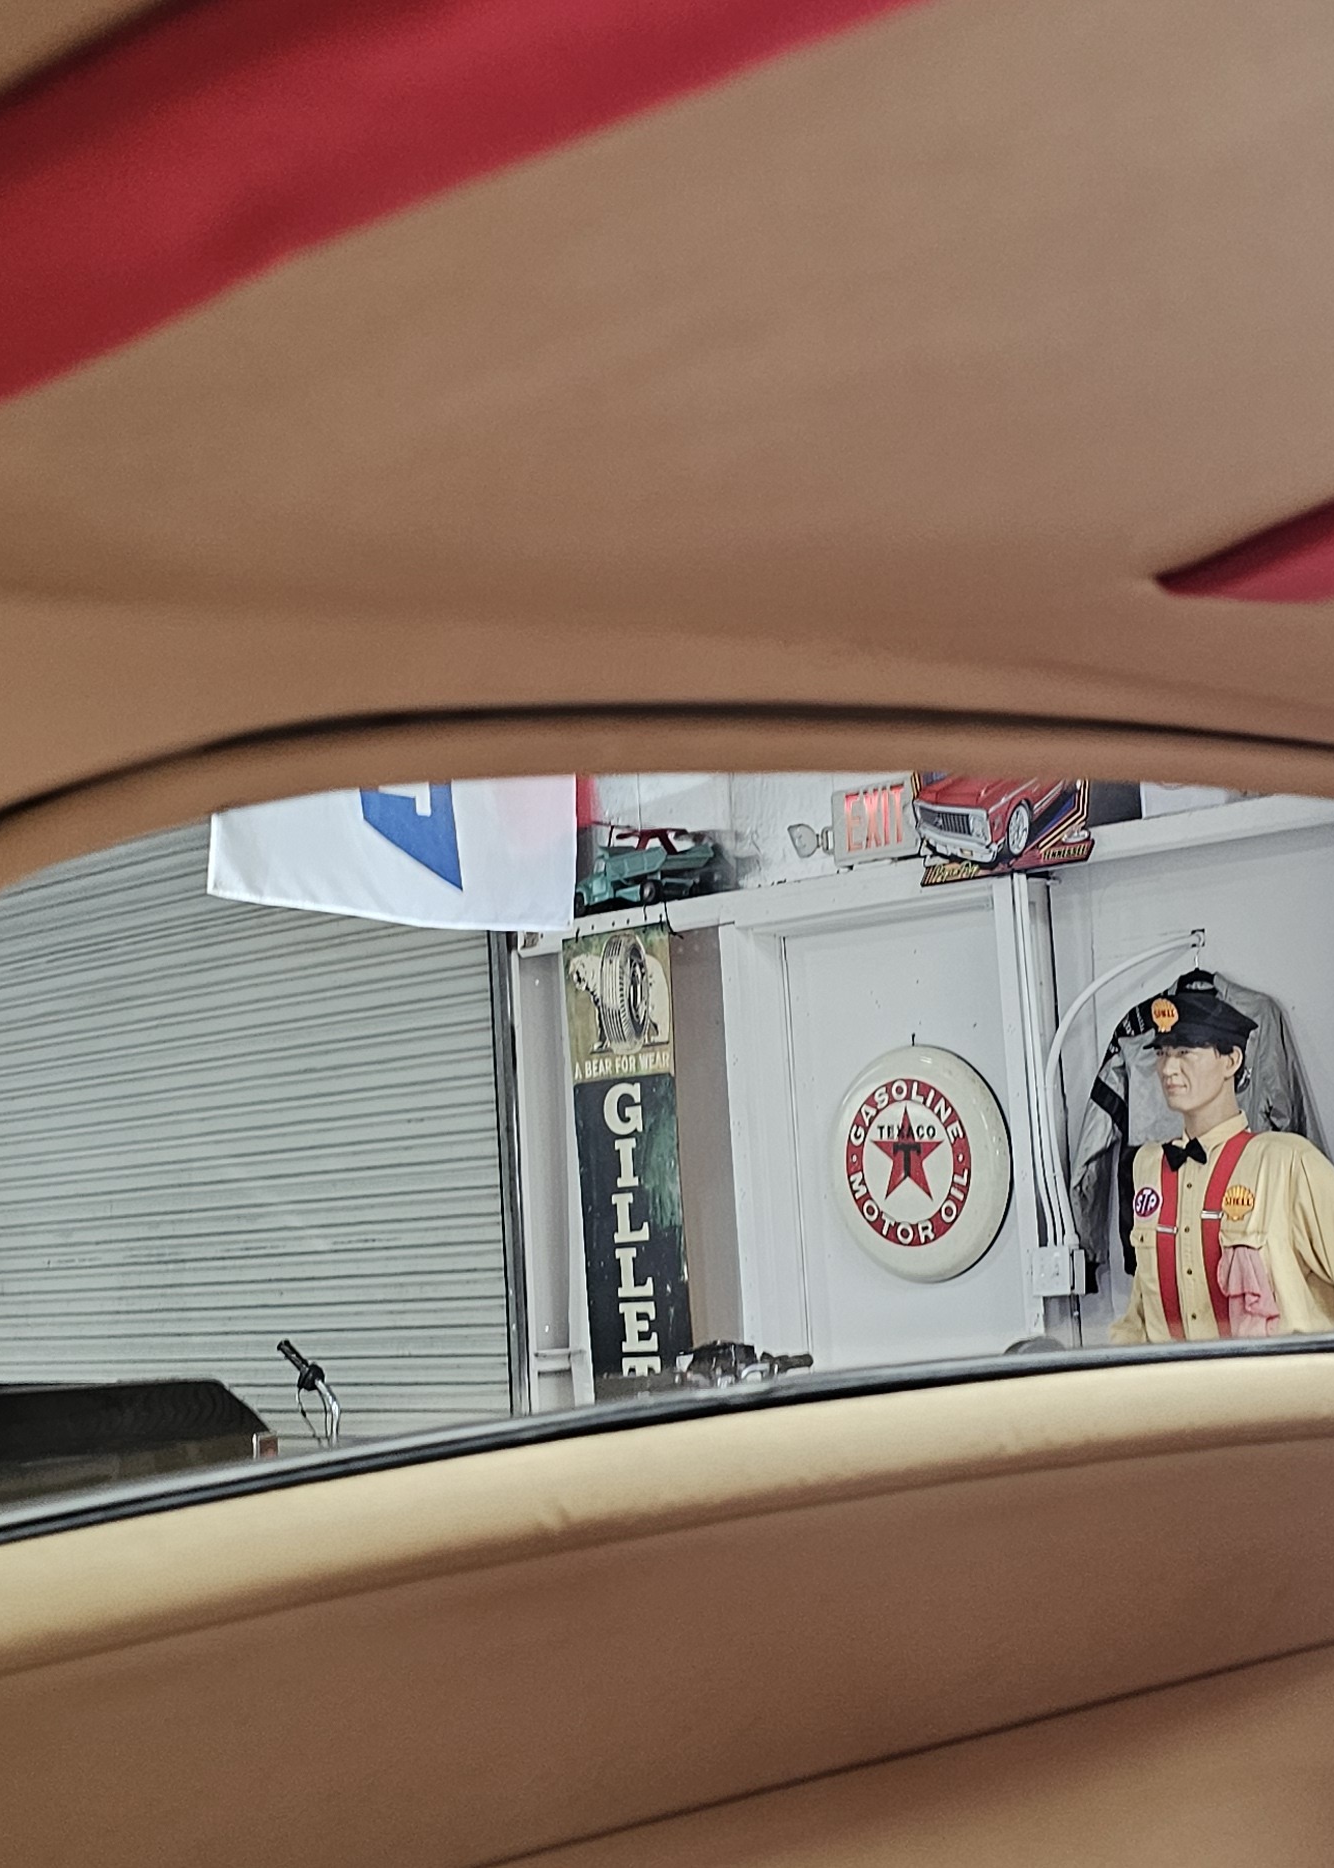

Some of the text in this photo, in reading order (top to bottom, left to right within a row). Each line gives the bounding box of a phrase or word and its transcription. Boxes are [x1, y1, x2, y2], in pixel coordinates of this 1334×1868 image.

[844, 782, 905, 853] EXIT
[574, 1050, 671, 1080] A BEAR FOR WEAR
[850, 1079, 964, 1147] GASOLINE
[877, 1124, 937, 1140] TEXACO
[892, 1142, 922, 1178] T
[850, 1168, 969, 1245] MOTOR OIL
[1135, 1188, 1159, 1215] STP
